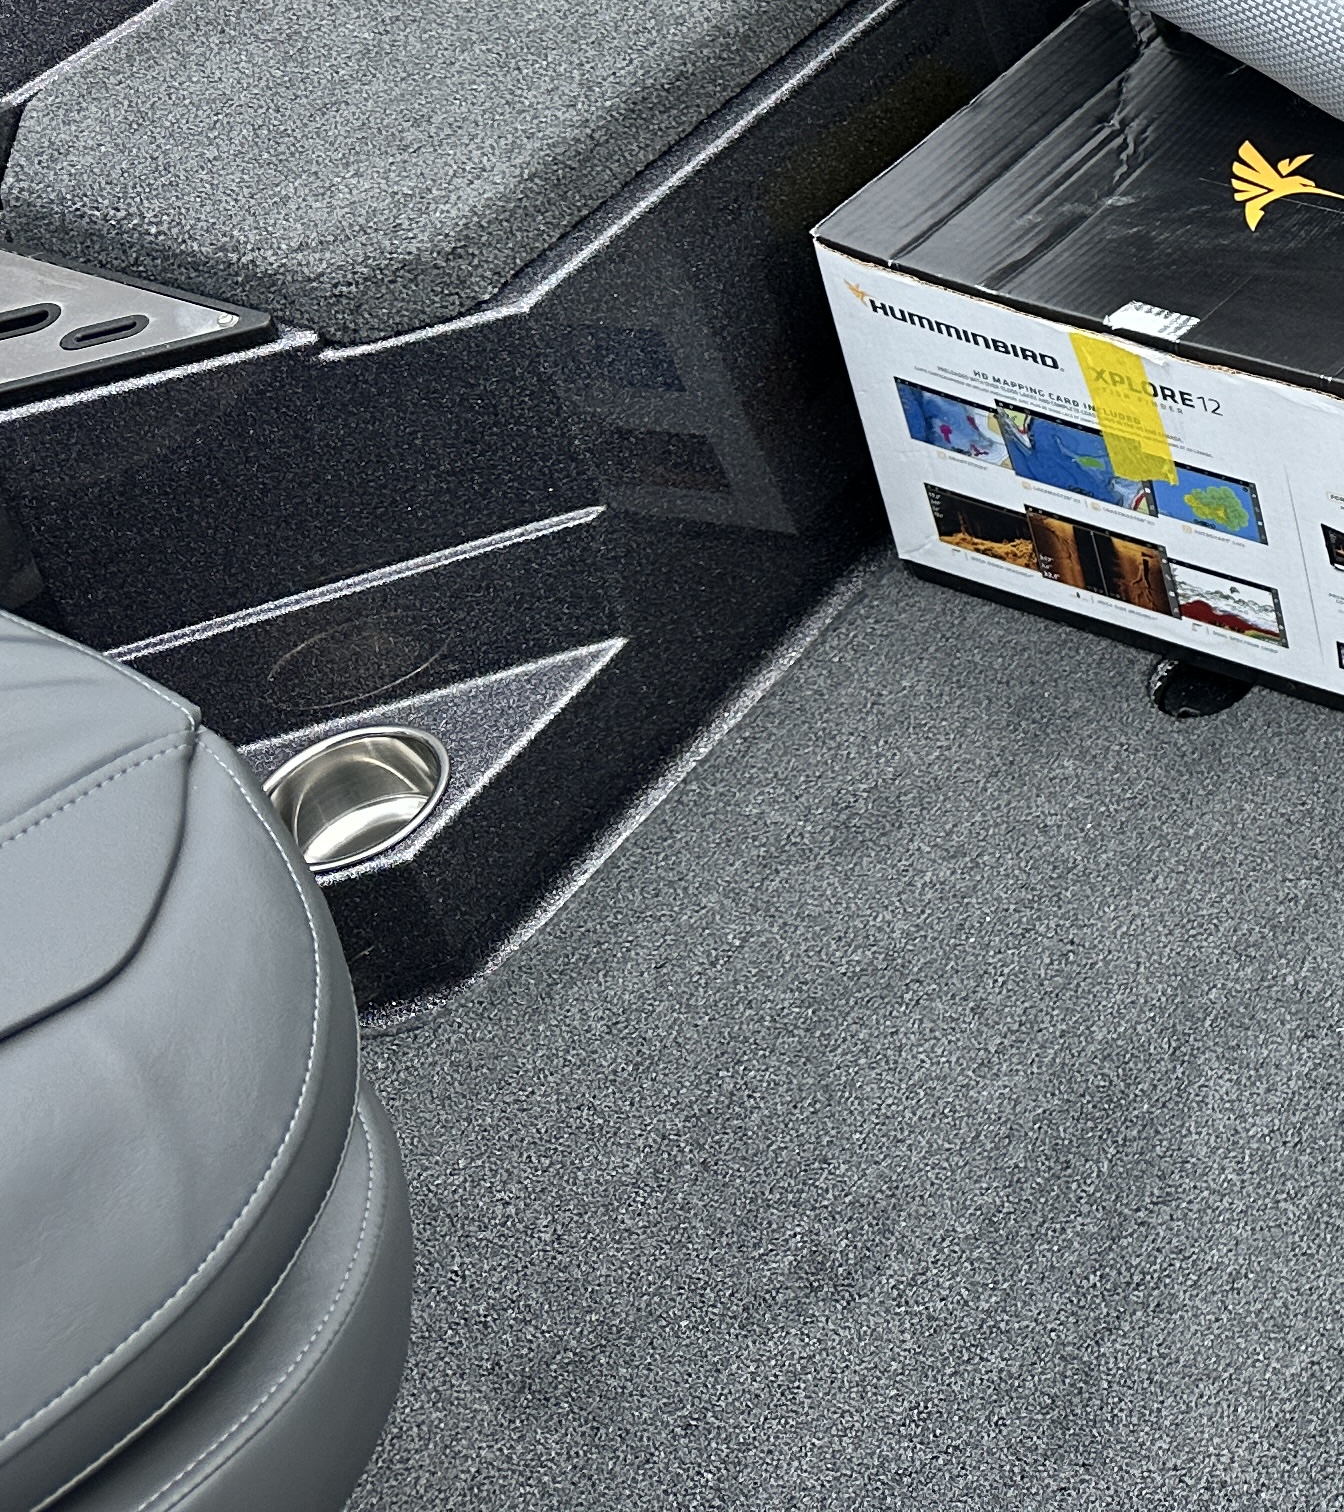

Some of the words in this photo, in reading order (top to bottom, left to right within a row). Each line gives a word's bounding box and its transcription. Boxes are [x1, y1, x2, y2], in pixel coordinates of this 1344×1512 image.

[869, 298, 1060, 370] HUMMINBIRD
[973, 369, 989, 381] HD
[991, 375, 1045, 397] MAPPING
[1047, 391, 1079, 407] CARD
